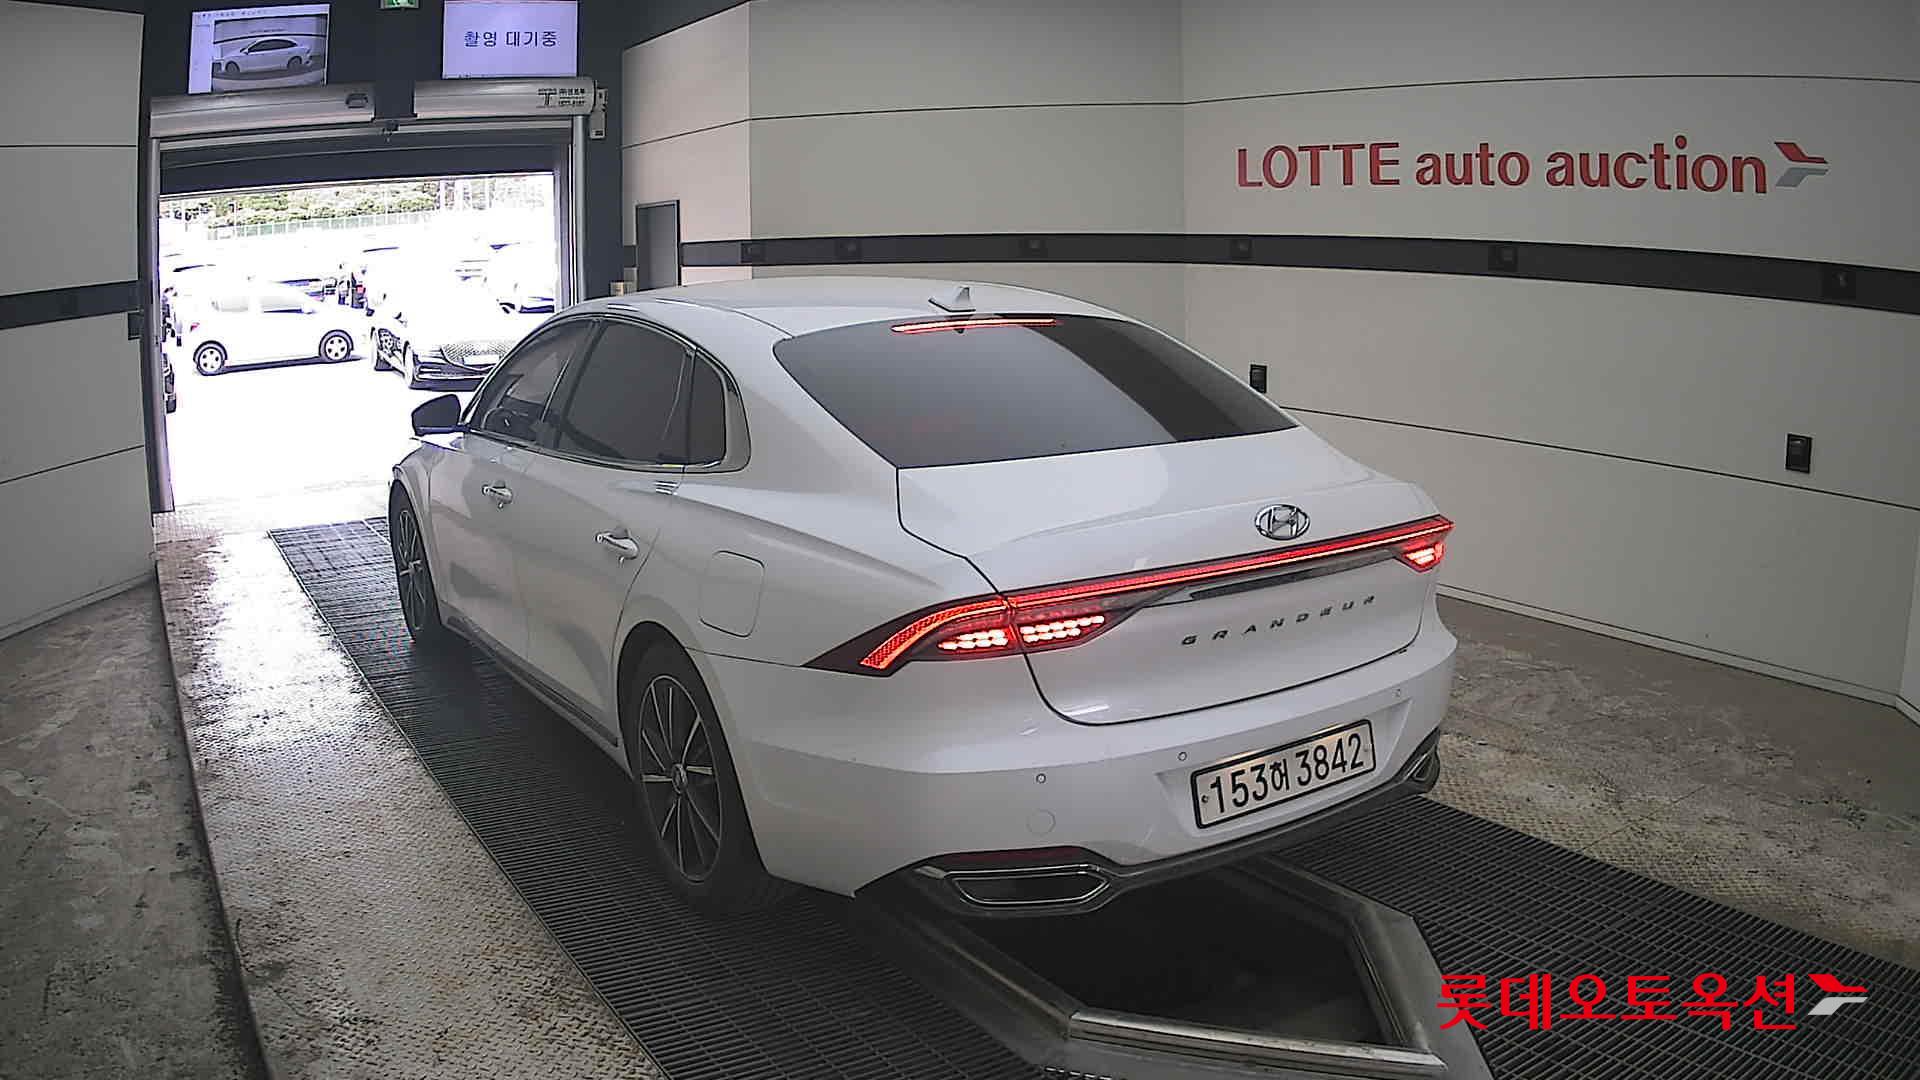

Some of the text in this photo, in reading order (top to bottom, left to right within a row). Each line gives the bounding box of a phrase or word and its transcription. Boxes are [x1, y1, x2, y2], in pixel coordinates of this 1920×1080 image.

[505, 31, 558, 47] 대기중
[1236, 135, 1767, 194] LOTTE auto auction
[1181, 595, 1375, 645] GRANDEUR
